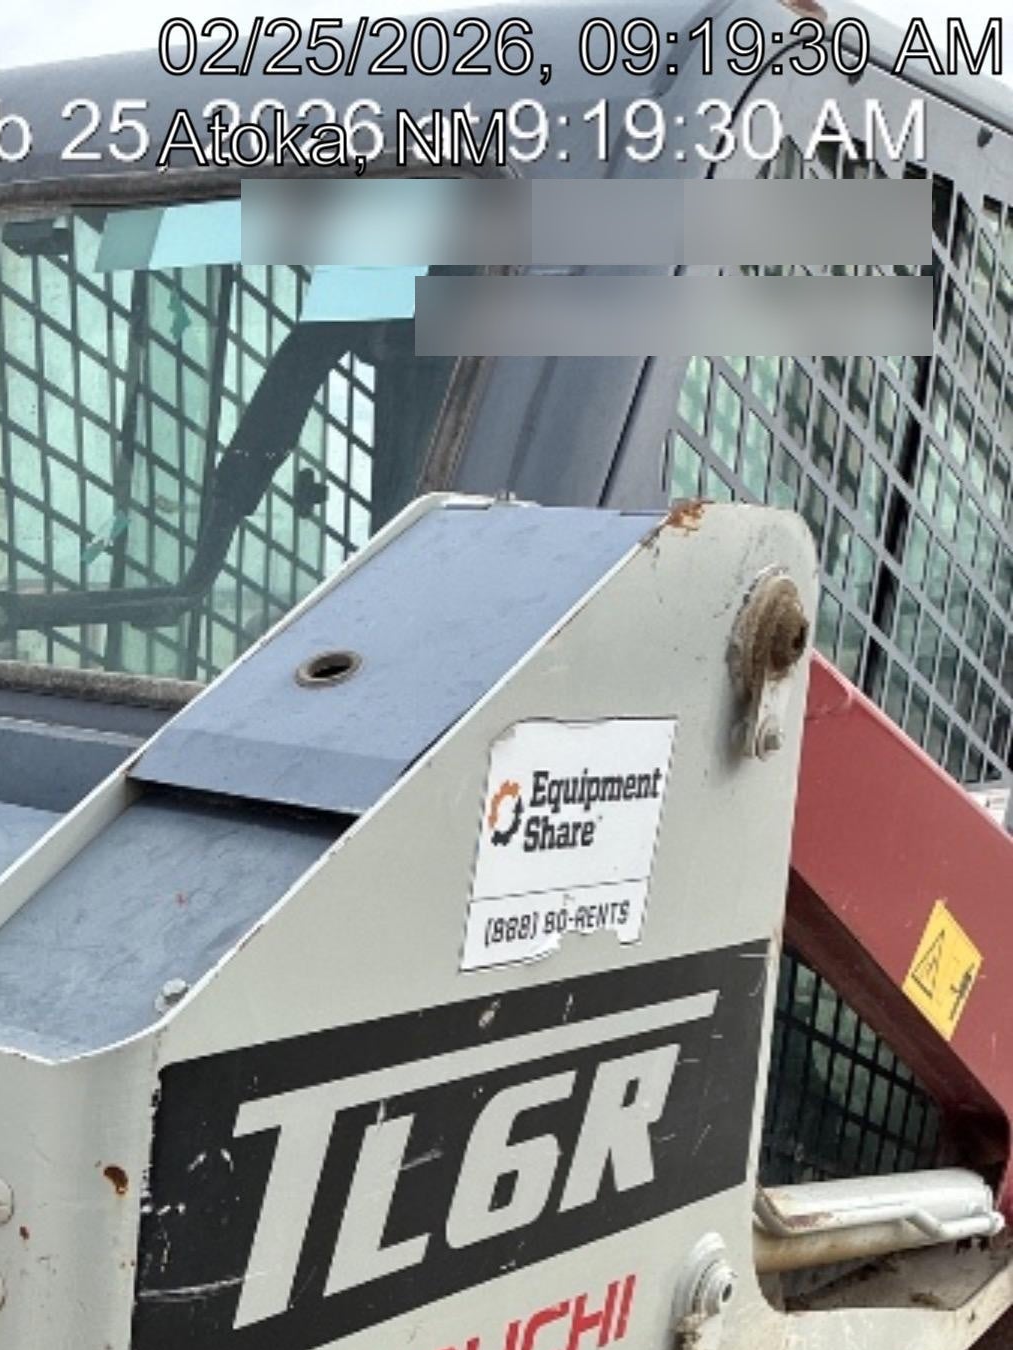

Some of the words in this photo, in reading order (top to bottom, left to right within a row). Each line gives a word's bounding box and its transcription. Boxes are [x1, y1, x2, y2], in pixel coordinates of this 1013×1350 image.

[529, 768, 662, 813] Equipment
[524, 814, 596, 852] Share
[485, 911, 539, 948] (888)
[229, 990, 720, 1331] TL6R
